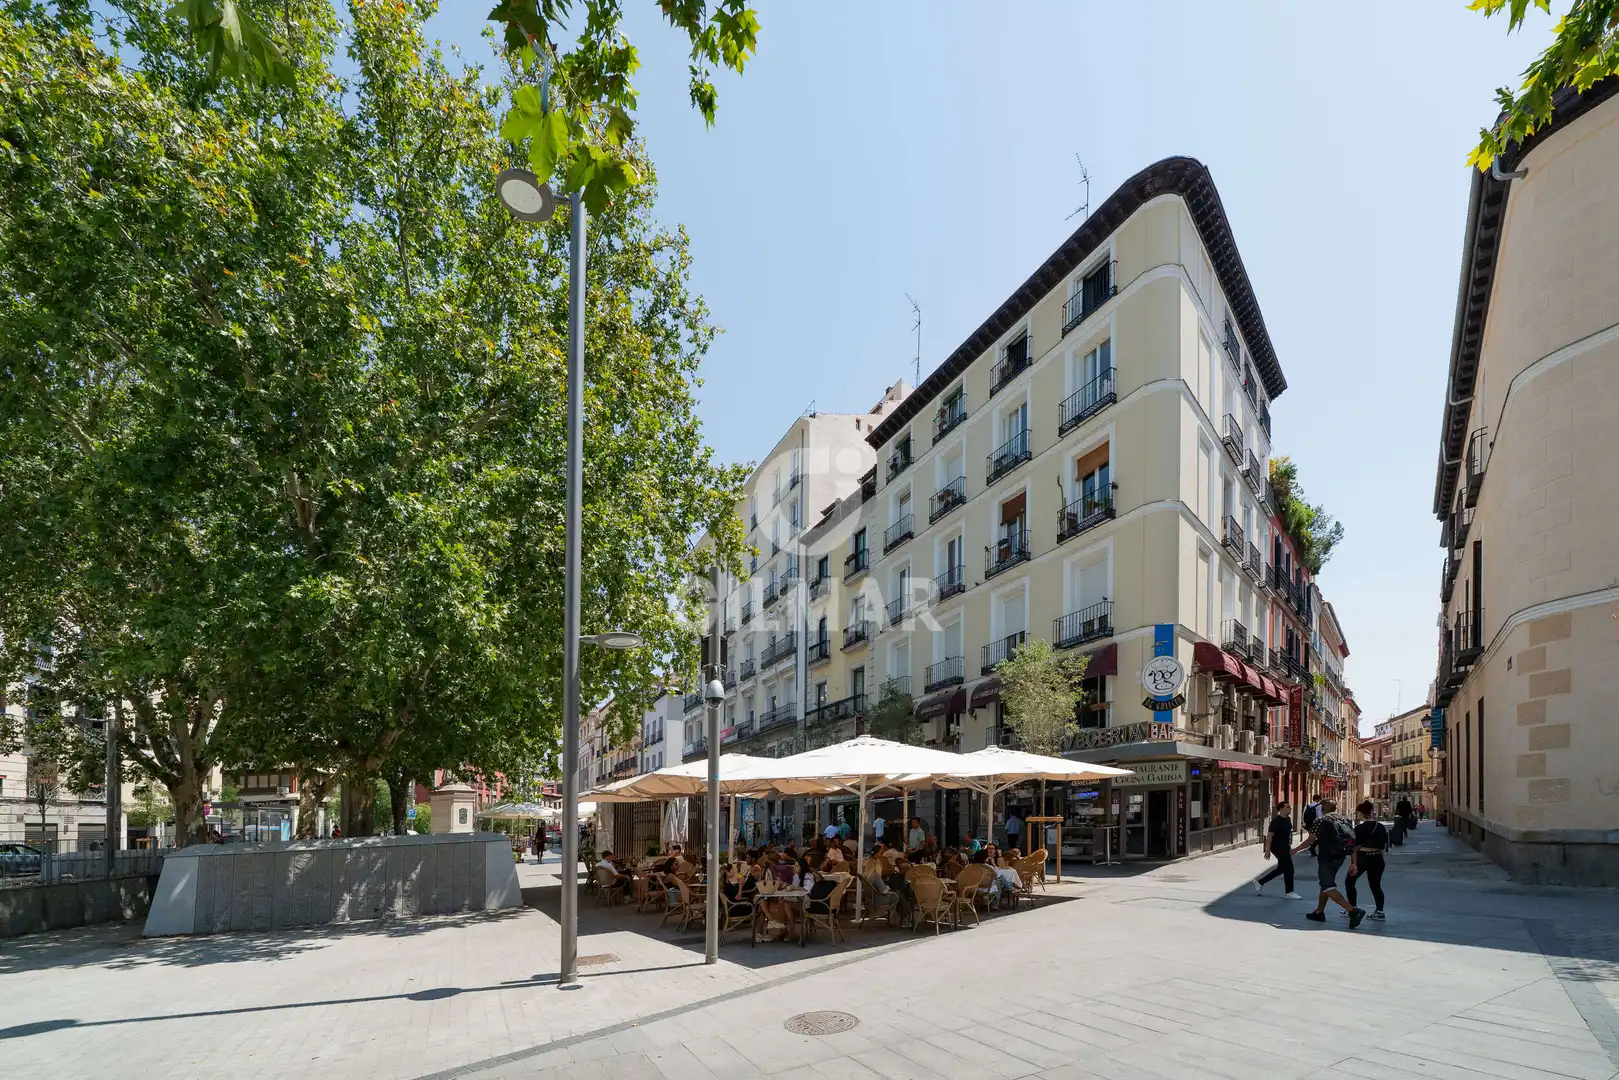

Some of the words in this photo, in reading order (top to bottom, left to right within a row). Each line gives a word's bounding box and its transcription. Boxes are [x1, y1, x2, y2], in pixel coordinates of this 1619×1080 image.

[1060, 724, 1141, 750] VECERIA
[1150, 723, 1175, 740] BAR
[1121, 763, 1180, 773] ESTAURANTE
